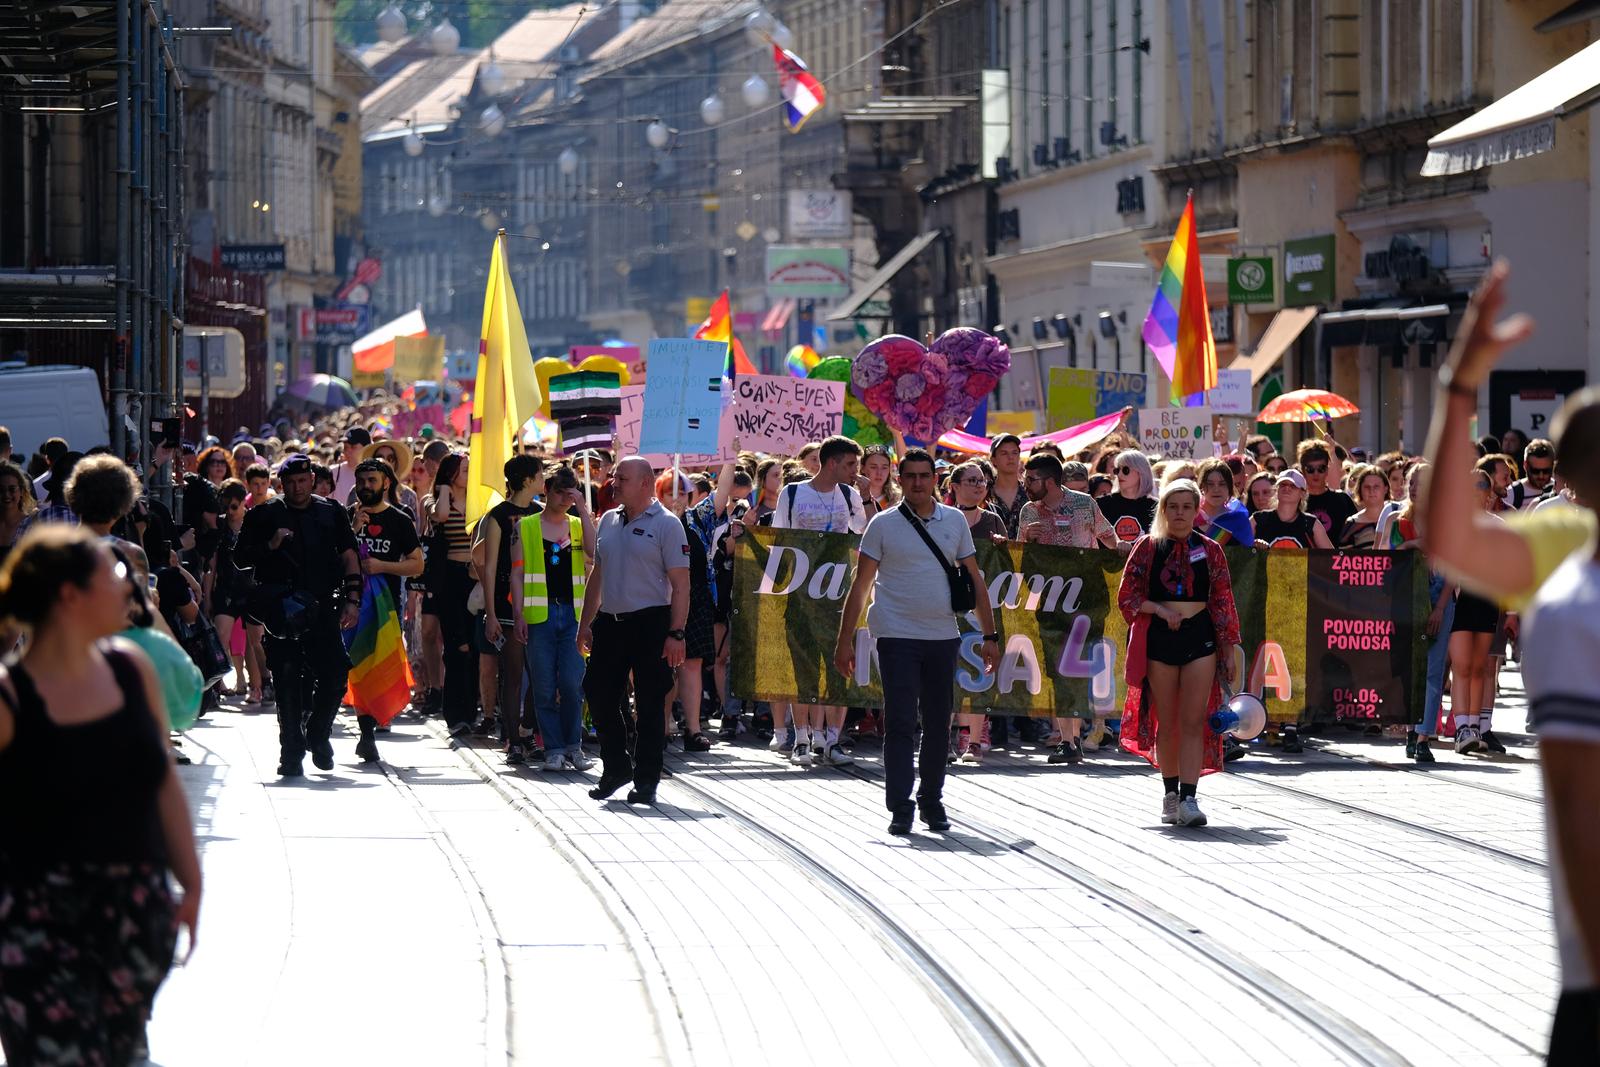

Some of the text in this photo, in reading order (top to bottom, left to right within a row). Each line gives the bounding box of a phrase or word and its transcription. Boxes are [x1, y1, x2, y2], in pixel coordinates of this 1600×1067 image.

[795, 383, 836, 407] EVEN
[734, 410, 778, 437] WRITE
[1161, 411, 1180, 426] BE
[1145, 424, 1210, 440] PROUD OF
[1143, 440, 1195, 451] WHO YOU
[1331, 556, 1392, 570] ZAGREB
[1339, 571, 1384, 586] PRIDE
[981, 570, 1084, 613] am
[1323, 619, 1395, 635] POVORKA
[1327, 634, 1391, 650] PONOSA
[1333, 688, 1383, 703] 04.06.
[1336, 704, 1380, 718] 2022.
